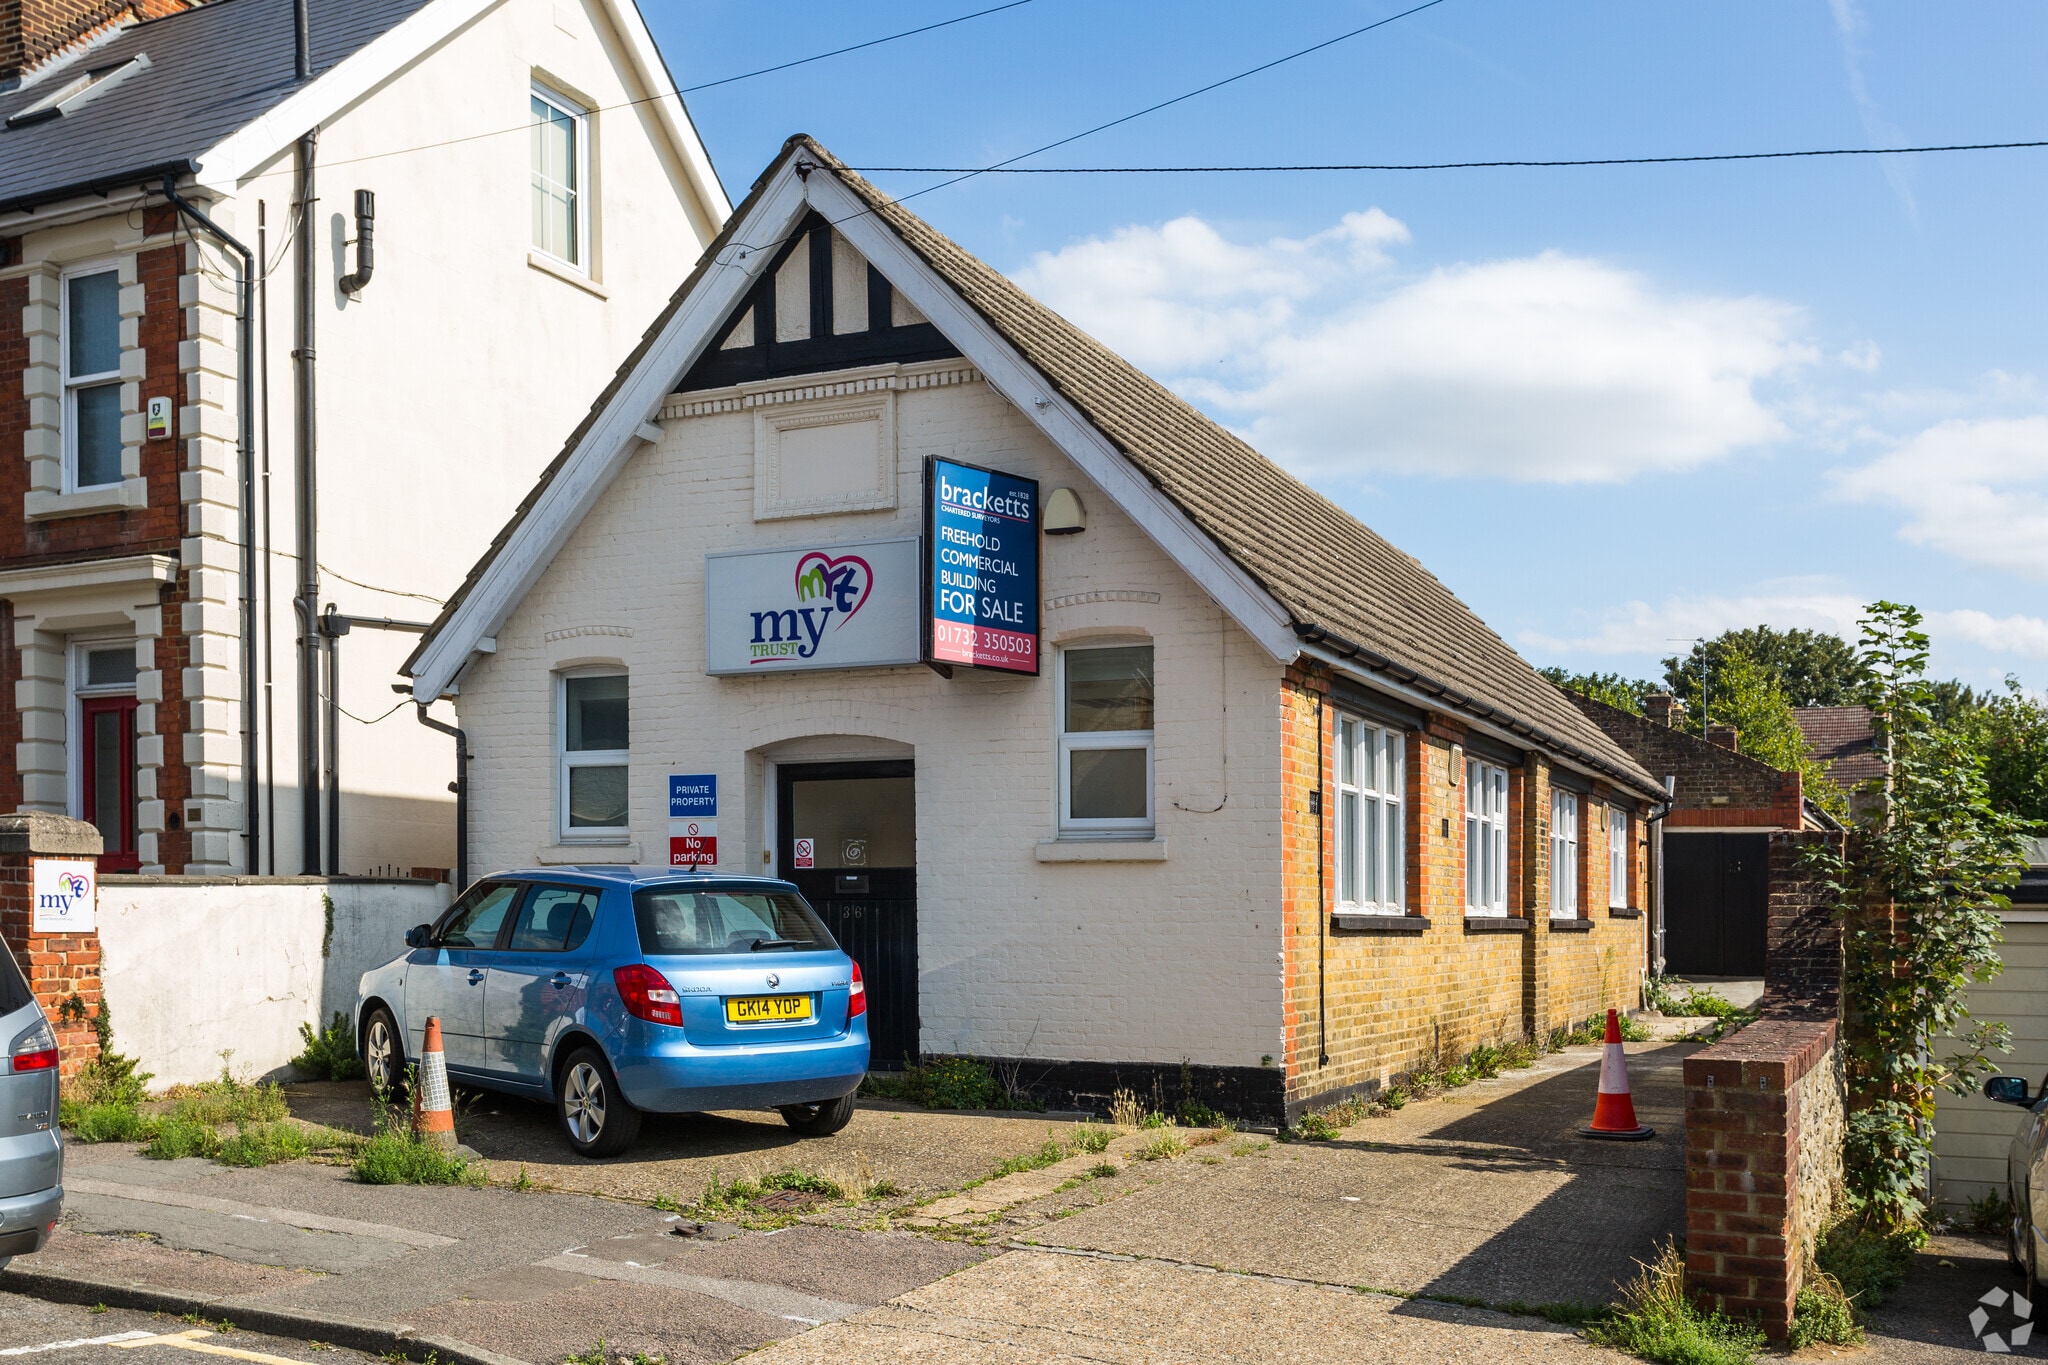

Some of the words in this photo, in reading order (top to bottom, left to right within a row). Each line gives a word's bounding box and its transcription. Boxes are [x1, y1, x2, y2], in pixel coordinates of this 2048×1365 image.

[941, 475, 1030, 519] bracketts
[941, 504, 971, 518] CHARTERED
[971, 512, 1001, 525] SURVEYORS
[941, 526, 1001, 552] FREEHOLD
[941, 548, 1019, 576] COMMERCIAL
[941, 570, 996, 594] BUILDING
[941, 589, 977, 616] FOR
[981, 597, 1024, 624] SALE
[750, 606, 834, 658] my
[938, 625, 979, 647] 01732
[983, 632, 1031, 655] 350503
[750, 642, 798, 657] TRUST
[961, 649, 1009, 663] bracketts.co.uk
[676, 785, 710, 795] PRIVATE
[671, 797, 715, 806] PROPERTY
[686, 838, 701, 849] No
[40, 894, 74, 916] my
[737, 1000, 770, 1017] GK14
[774, 998, 801, 1015] YOP
